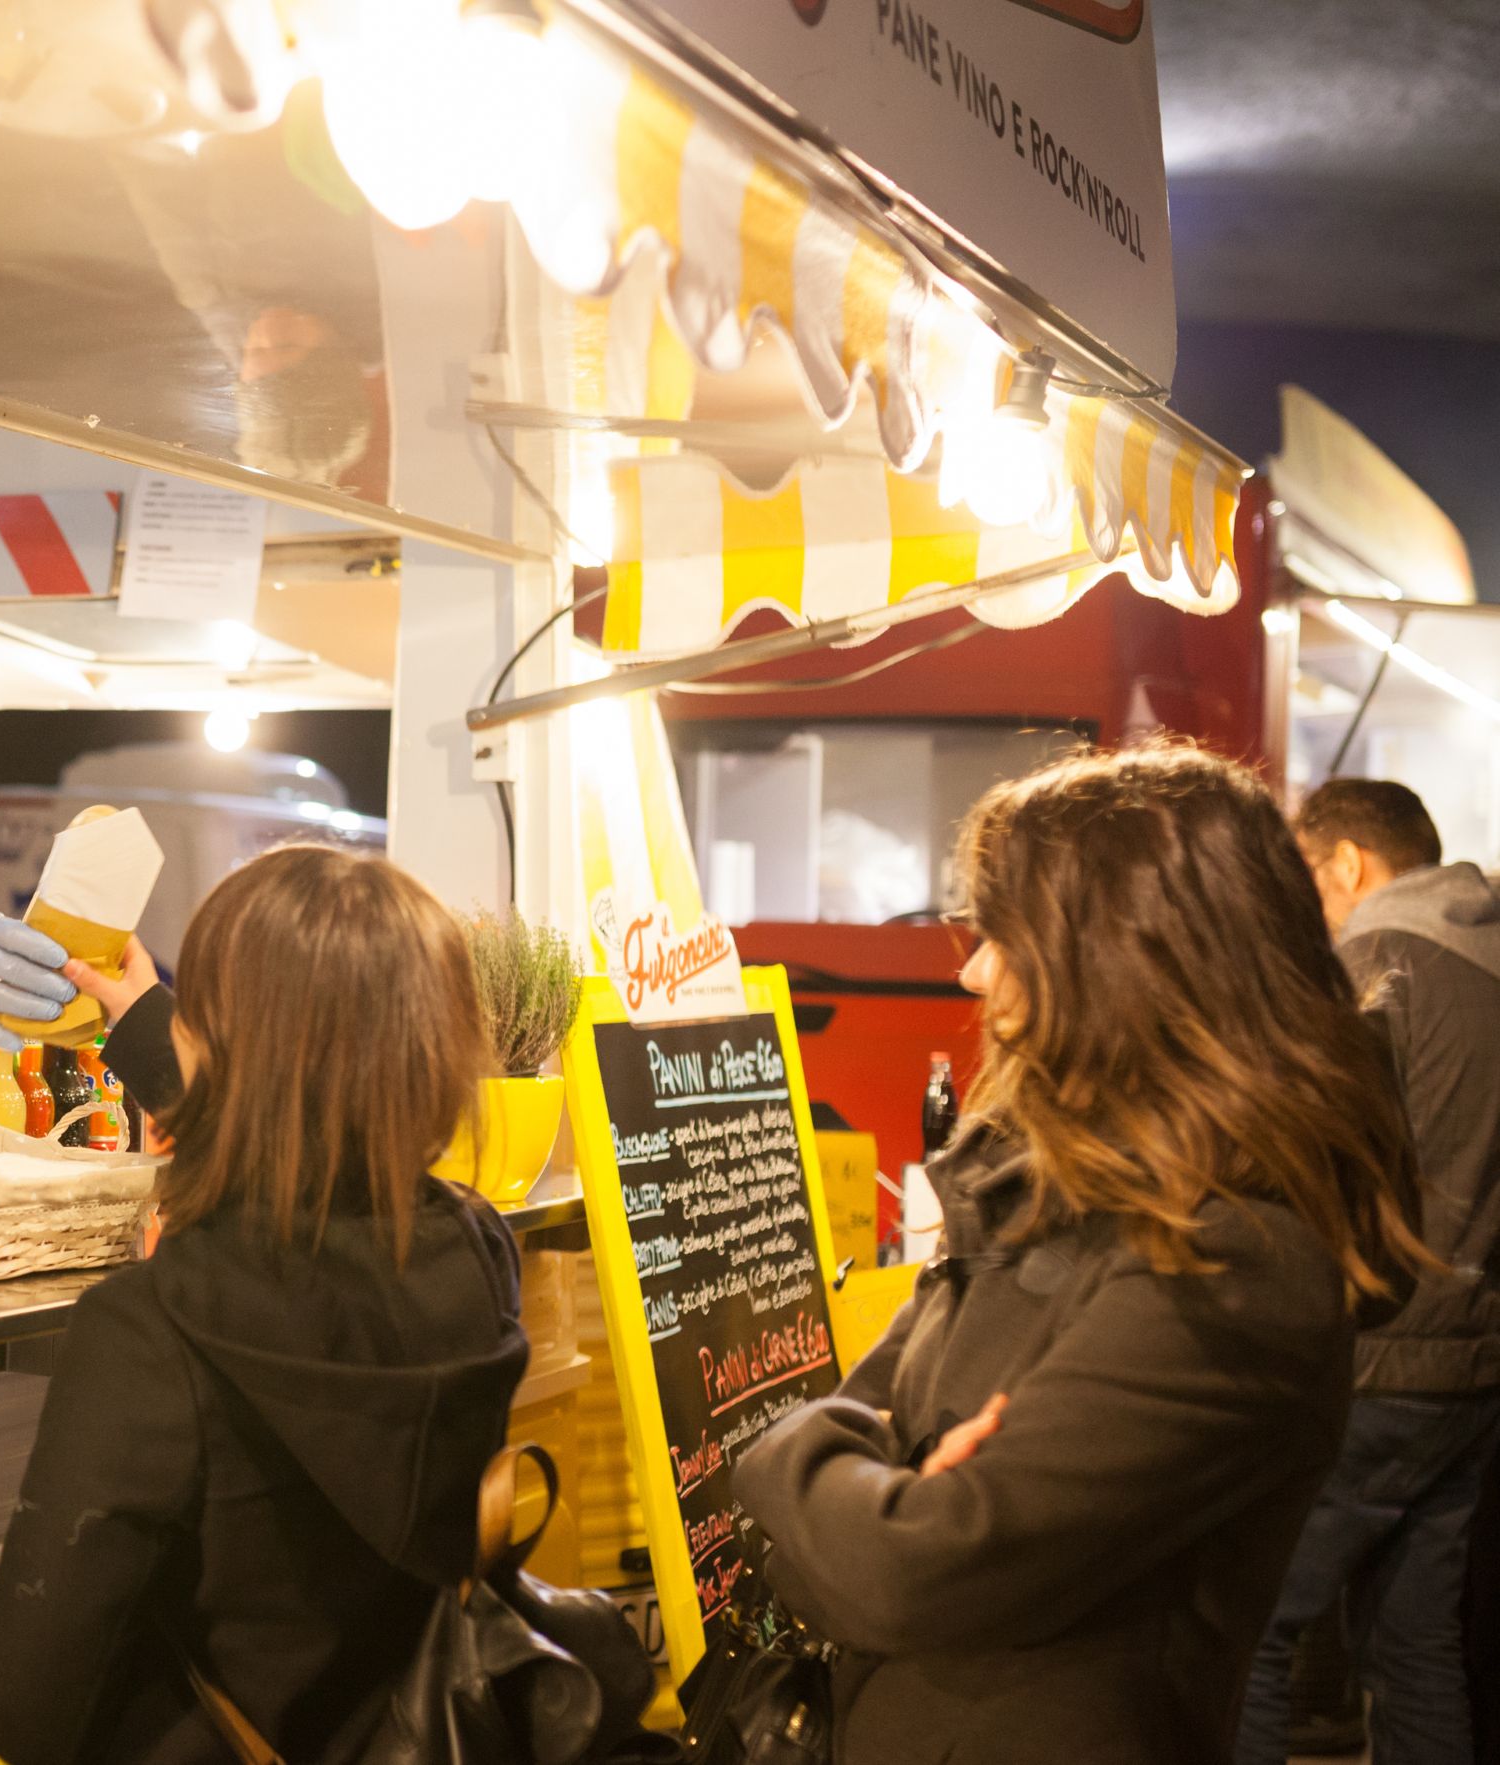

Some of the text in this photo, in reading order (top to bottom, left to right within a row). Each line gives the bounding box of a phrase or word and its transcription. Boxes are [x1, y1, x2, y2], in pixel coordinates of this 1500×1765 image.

[877, 0, 1145, 263] PANE VINO E ROCK'N'ROLL
[646, 1039, 706, 1096] PANINI
[709, 1052, 724, 1090] di
[643, 1291, 679, 1332] JANIS
[698, 1343, 750, 1404] PANINI
